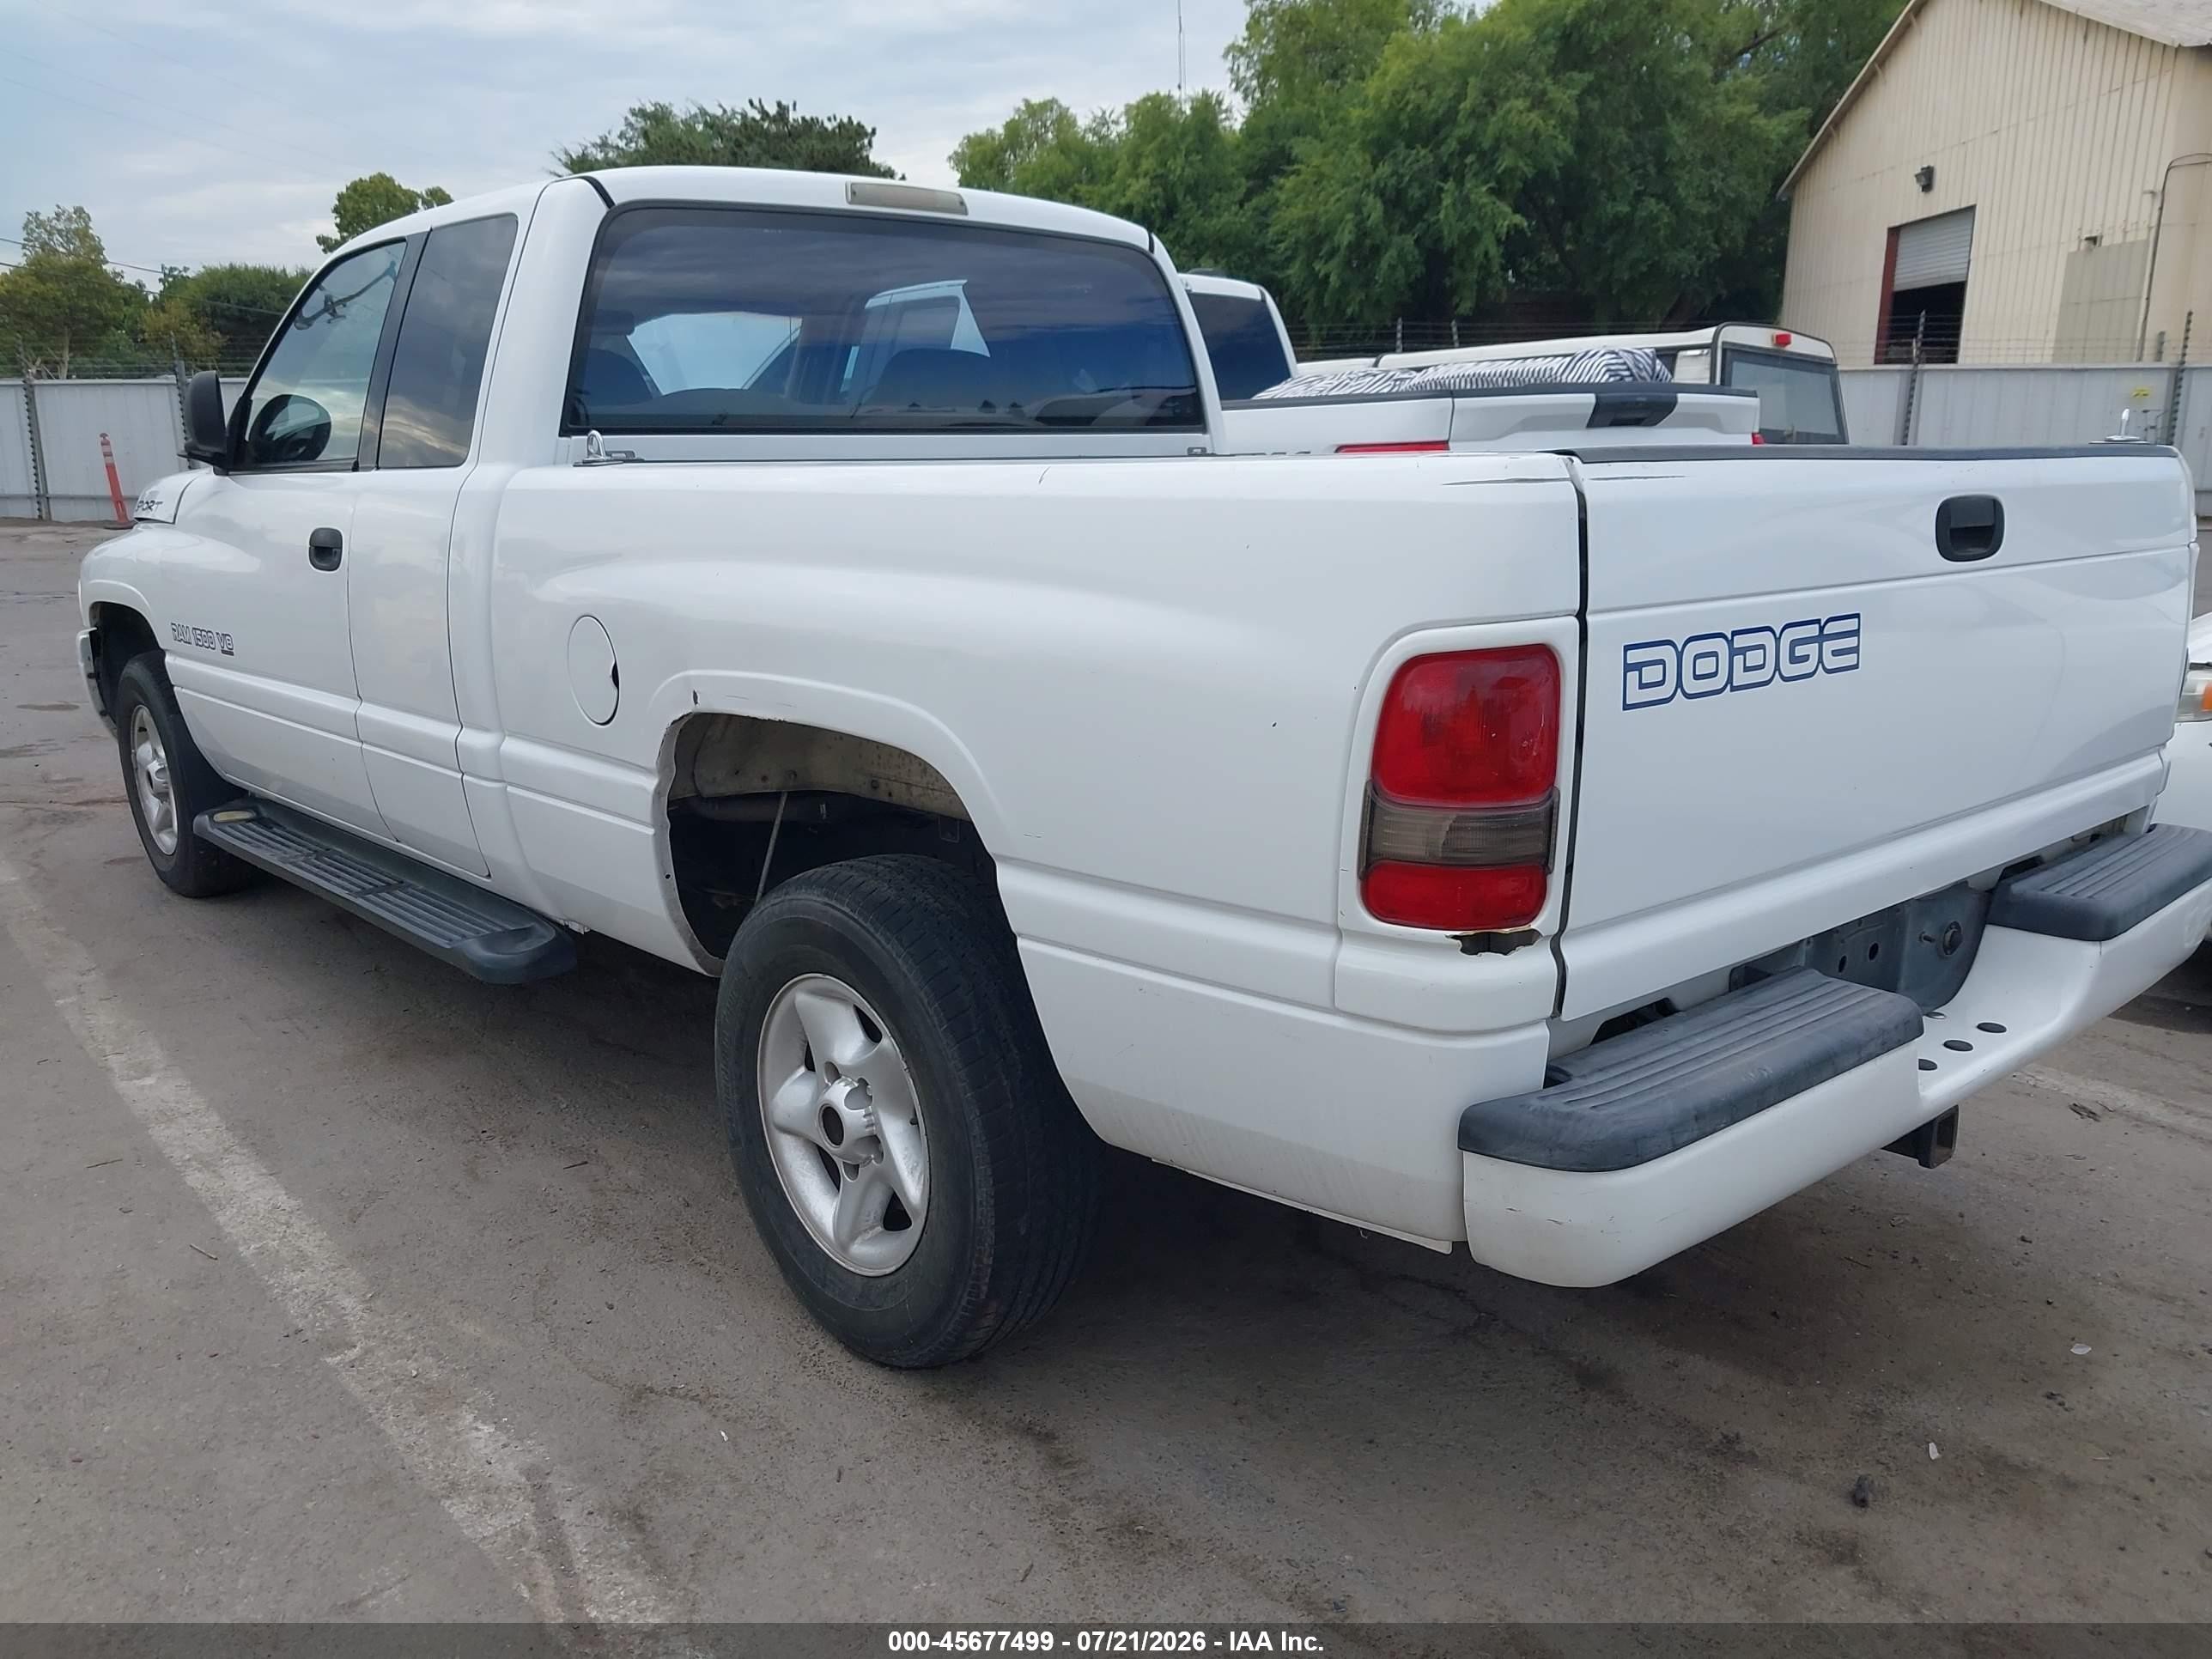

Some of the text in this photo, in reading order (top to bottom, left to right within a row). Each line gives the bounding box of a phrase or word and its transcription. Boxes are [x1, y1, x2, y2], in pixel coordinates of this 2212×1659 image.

[135, 500, 164, 513] PORT
[171, 622, 234, 651] RAM 1500 V8
[1622, 612, 1862, 711] DODGE
